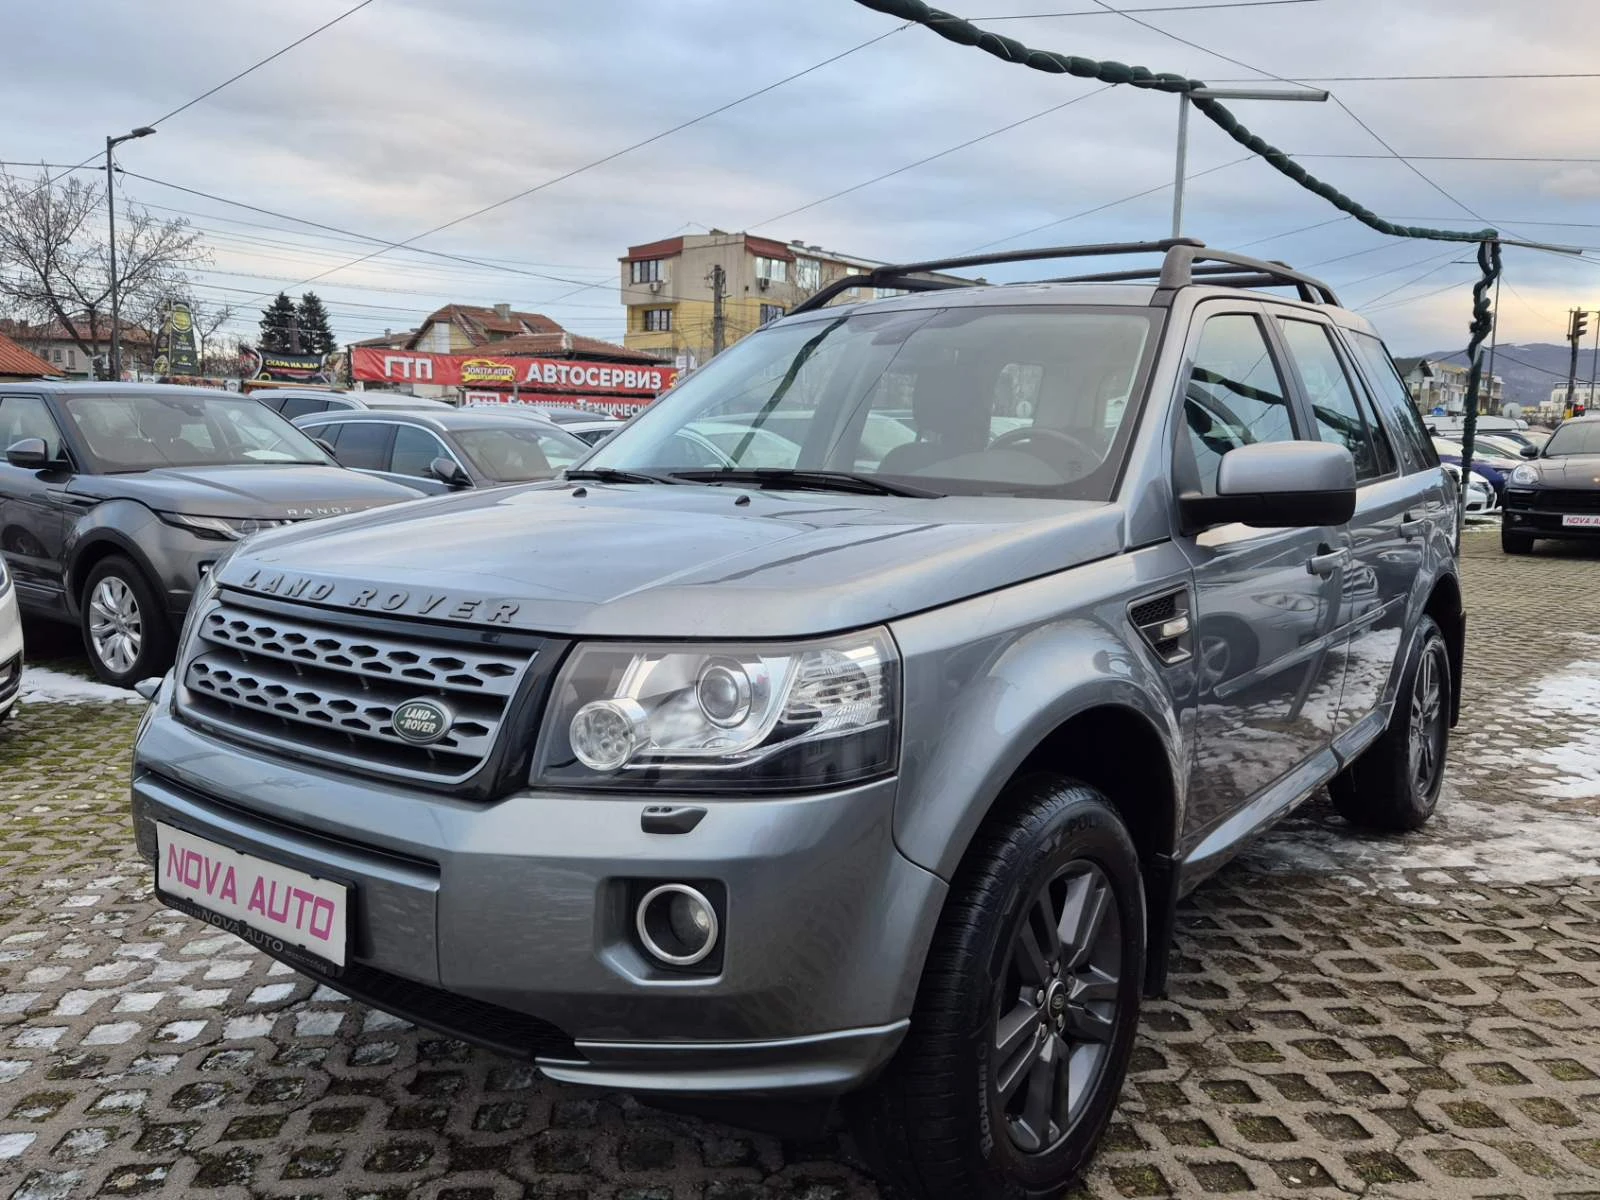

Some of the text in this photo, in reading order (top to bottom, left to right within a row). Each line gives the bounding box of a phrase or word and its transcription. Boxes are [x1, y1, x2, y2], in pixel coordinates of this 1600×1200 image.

[384, 355, 433, 380] ГТП
[526, 363, 662, 389] АВТОСЕРВИЗ
[242, 569, 522, 625] LAND ROVER
[403, 718, 437, 734] ROVER
[404, 707, 431, 721] LAND
[167, 843, 336, 942] NOVA AUTO
[201, 909, 242, 936] NOVA
[243, 929, 284, 953] AUTO
